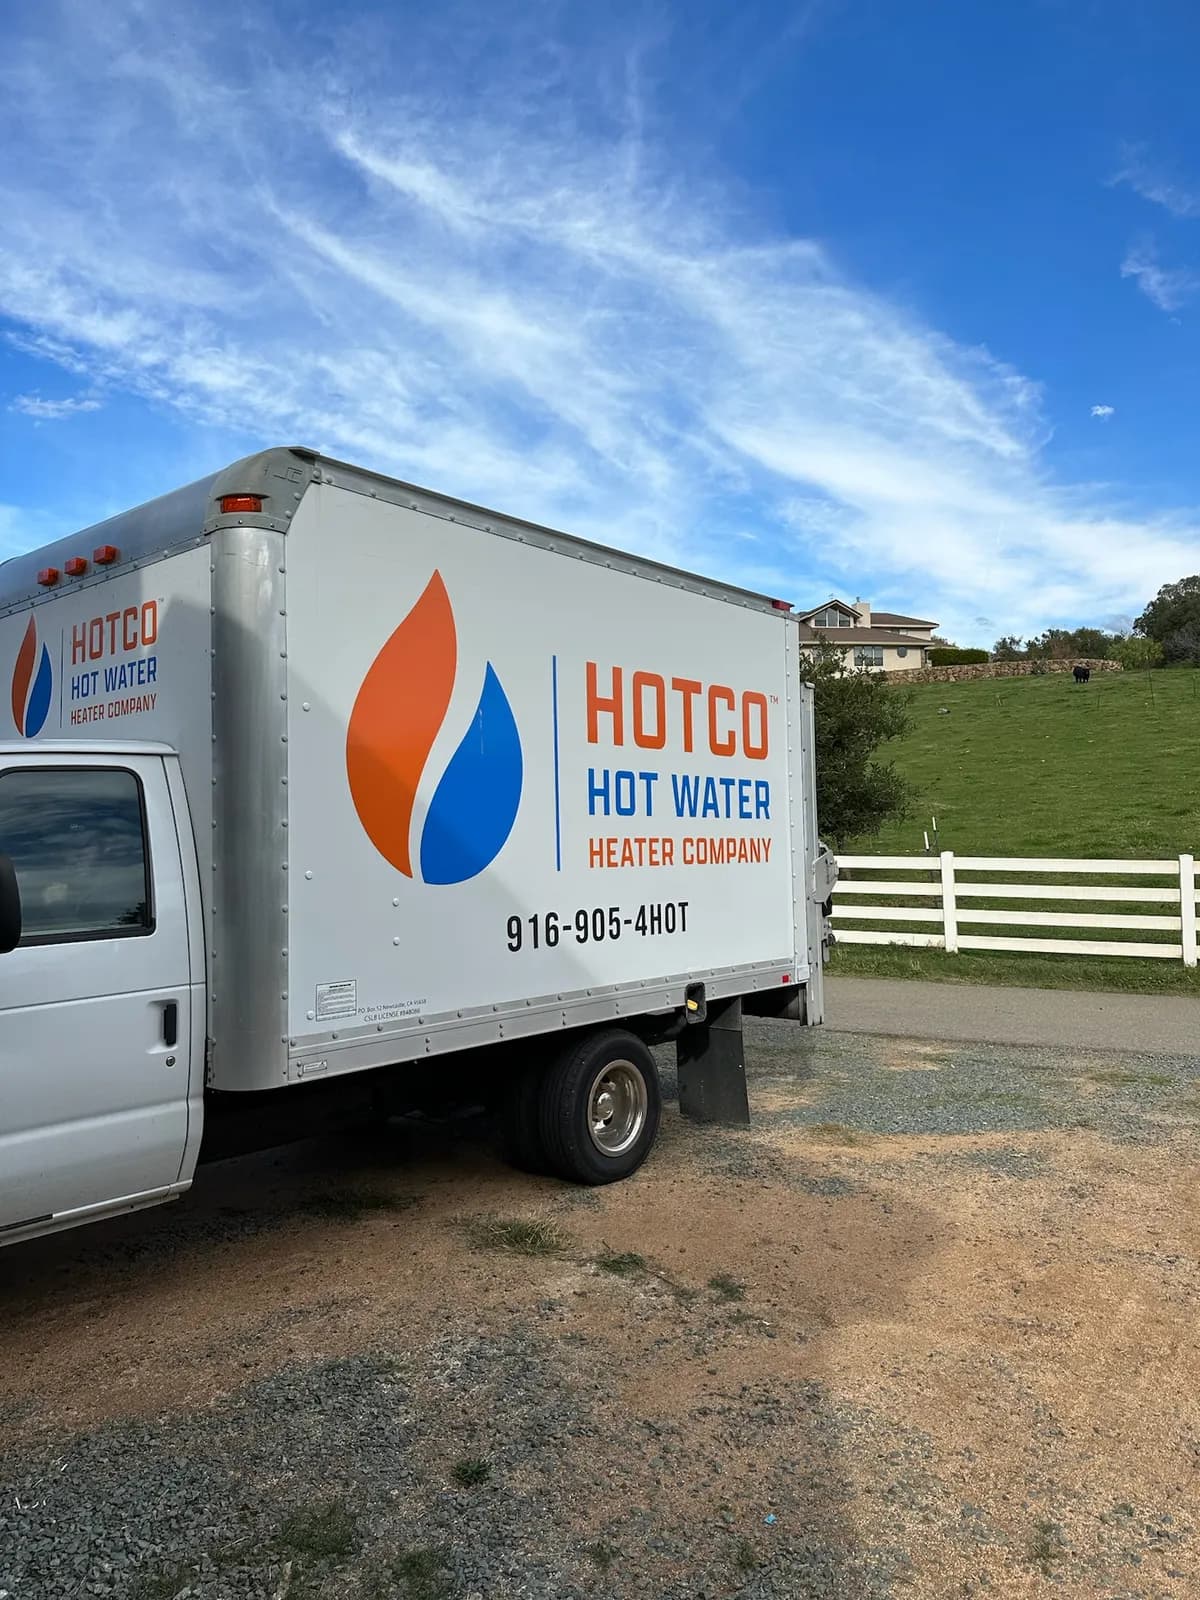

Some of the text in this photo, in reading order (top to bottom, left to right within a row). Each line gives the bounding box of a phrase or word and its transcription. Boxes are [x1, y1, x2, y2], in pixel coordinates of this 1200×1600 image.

[72, 600, 157, 665] HOTCO
[71, 656, 157, 700] HOT WATER
[71, 694, 157, 725] HEATER COMPANY
[586, 661, 768, 760] HOTCO
[588, 768, 770, 819] HOT WATER
[589, 838, 772, 868] HEATER COMPANY
[507, 901, 689, 952] 916-905-4HOT
[364, 1014, 378, 1022] CSLB
[378, 1010, 400, 1020] LICENSE
